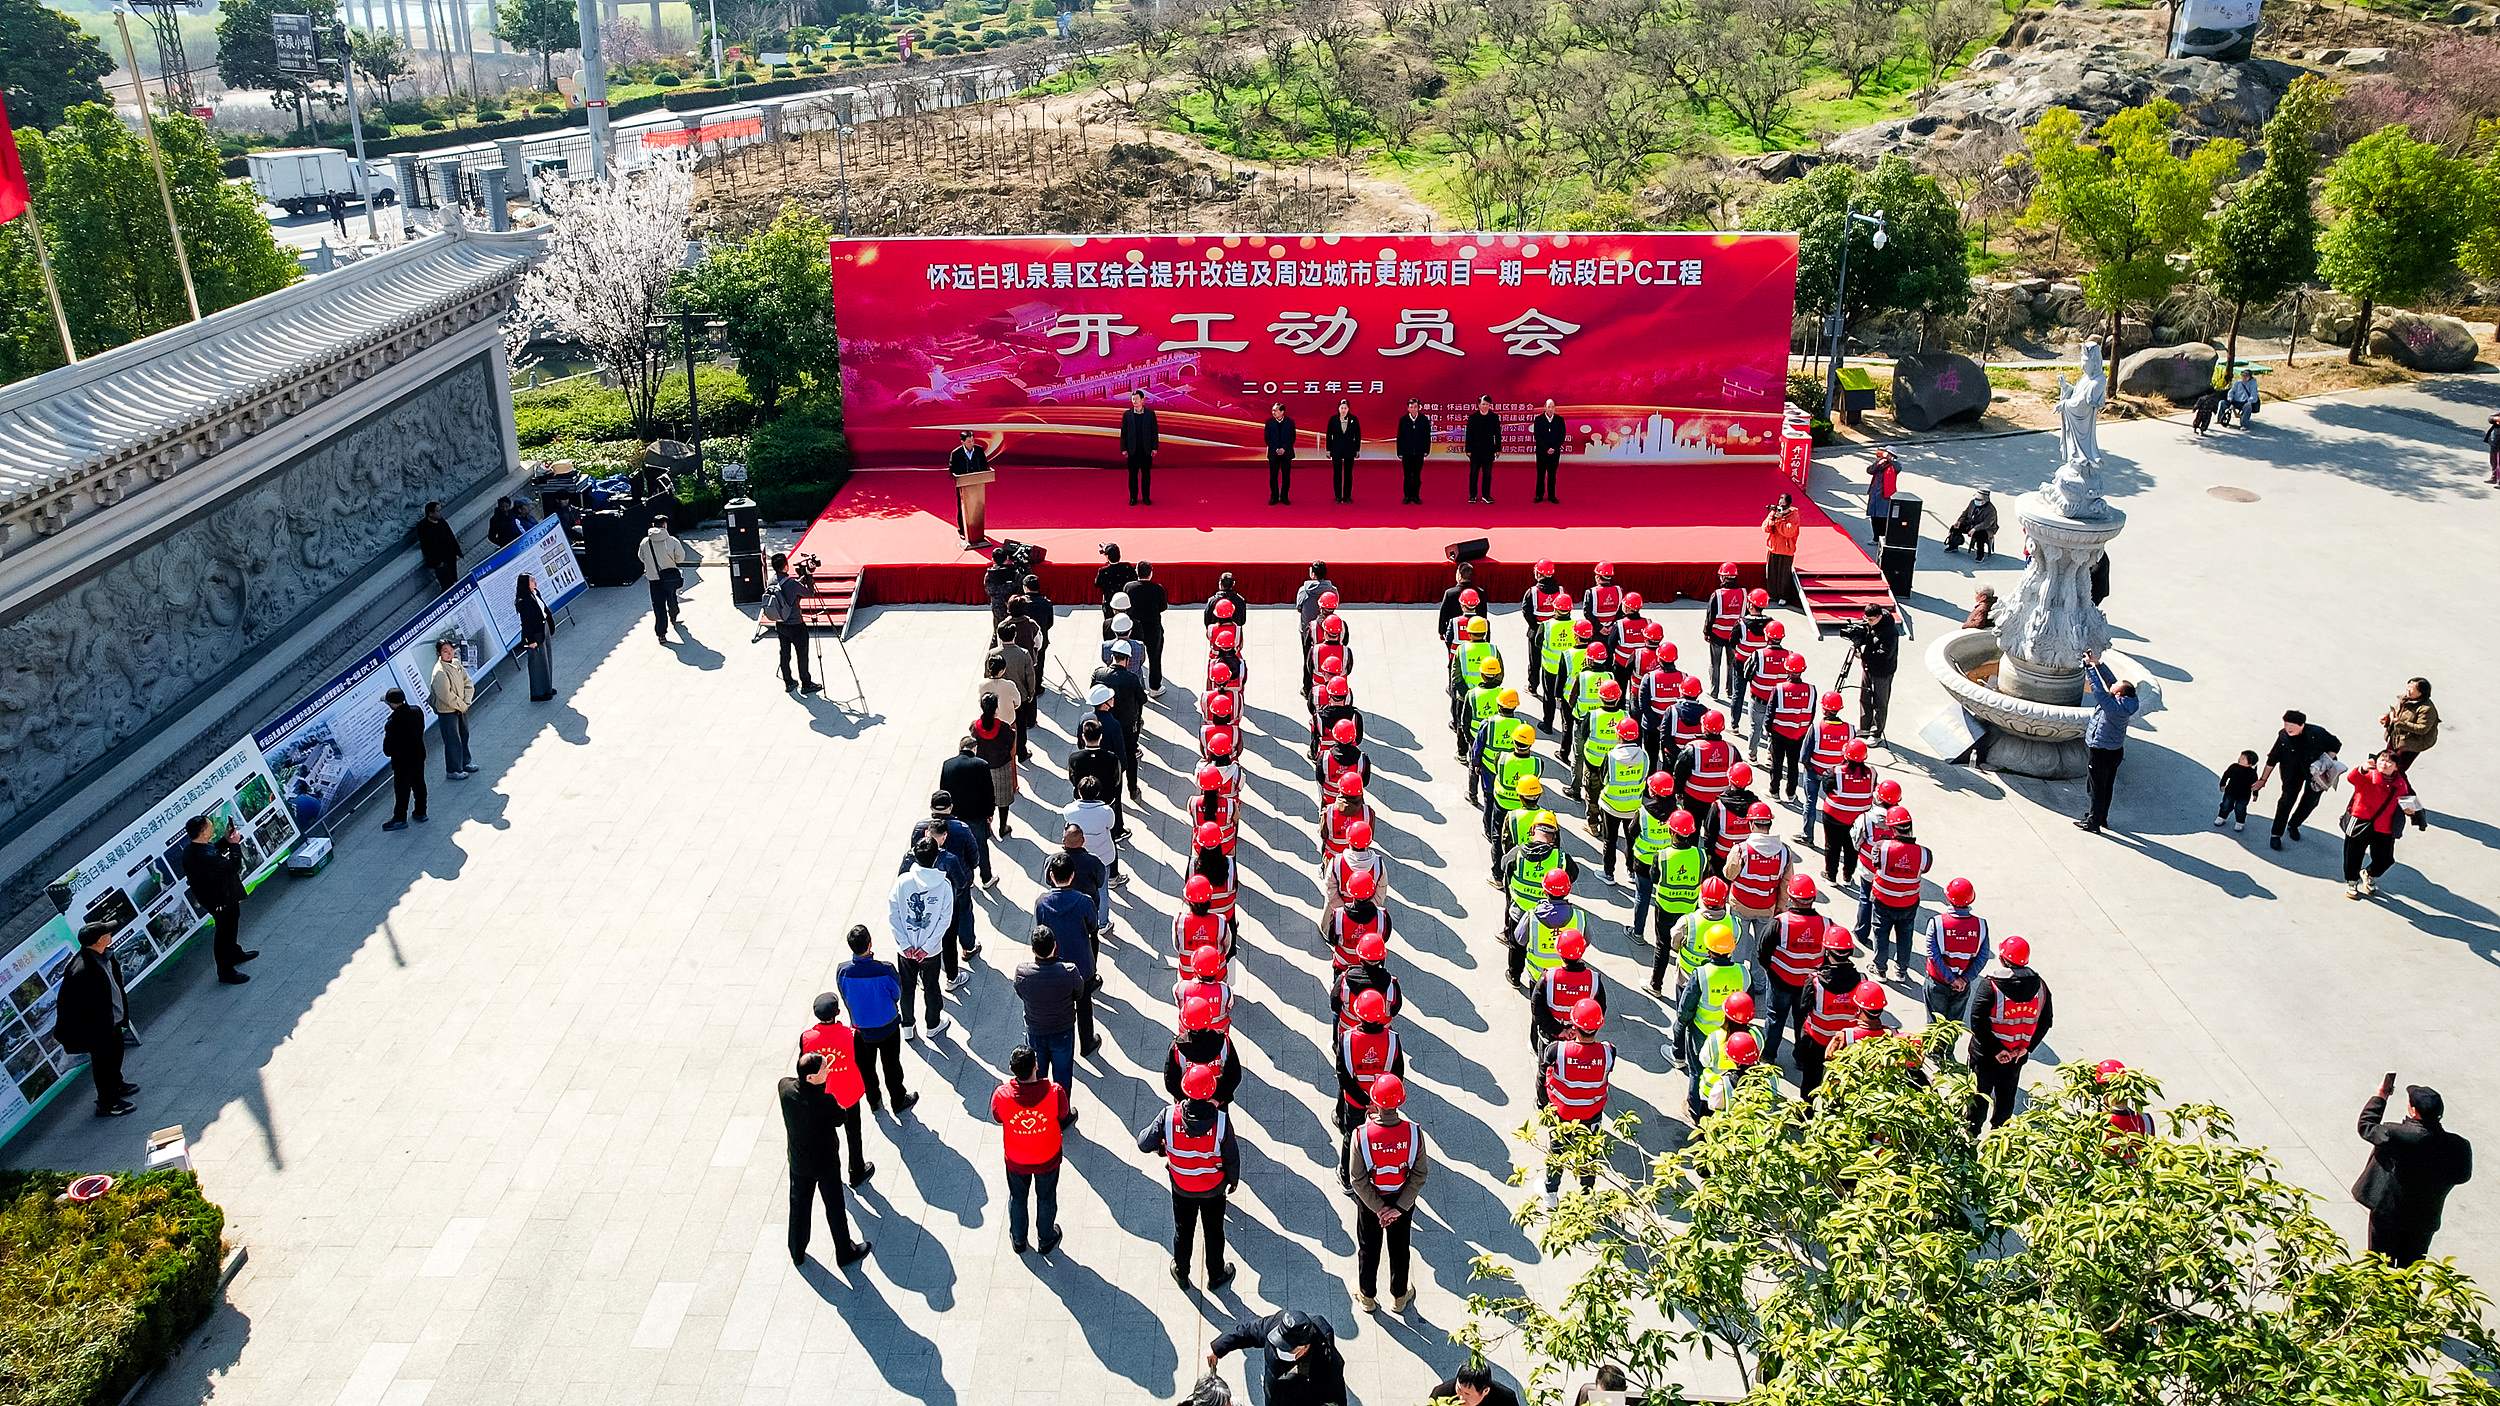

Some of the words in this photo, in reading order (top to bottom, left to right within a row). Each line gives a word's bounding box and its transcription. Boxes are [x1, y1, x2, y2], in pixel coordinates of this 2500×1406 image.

[926, 259, 1702, 291] 怀远白乳泉景区综合提升改造及周边城市更新项目一期一标段EPC工程
[1046, 305, 1581, 357] 开工动员会
